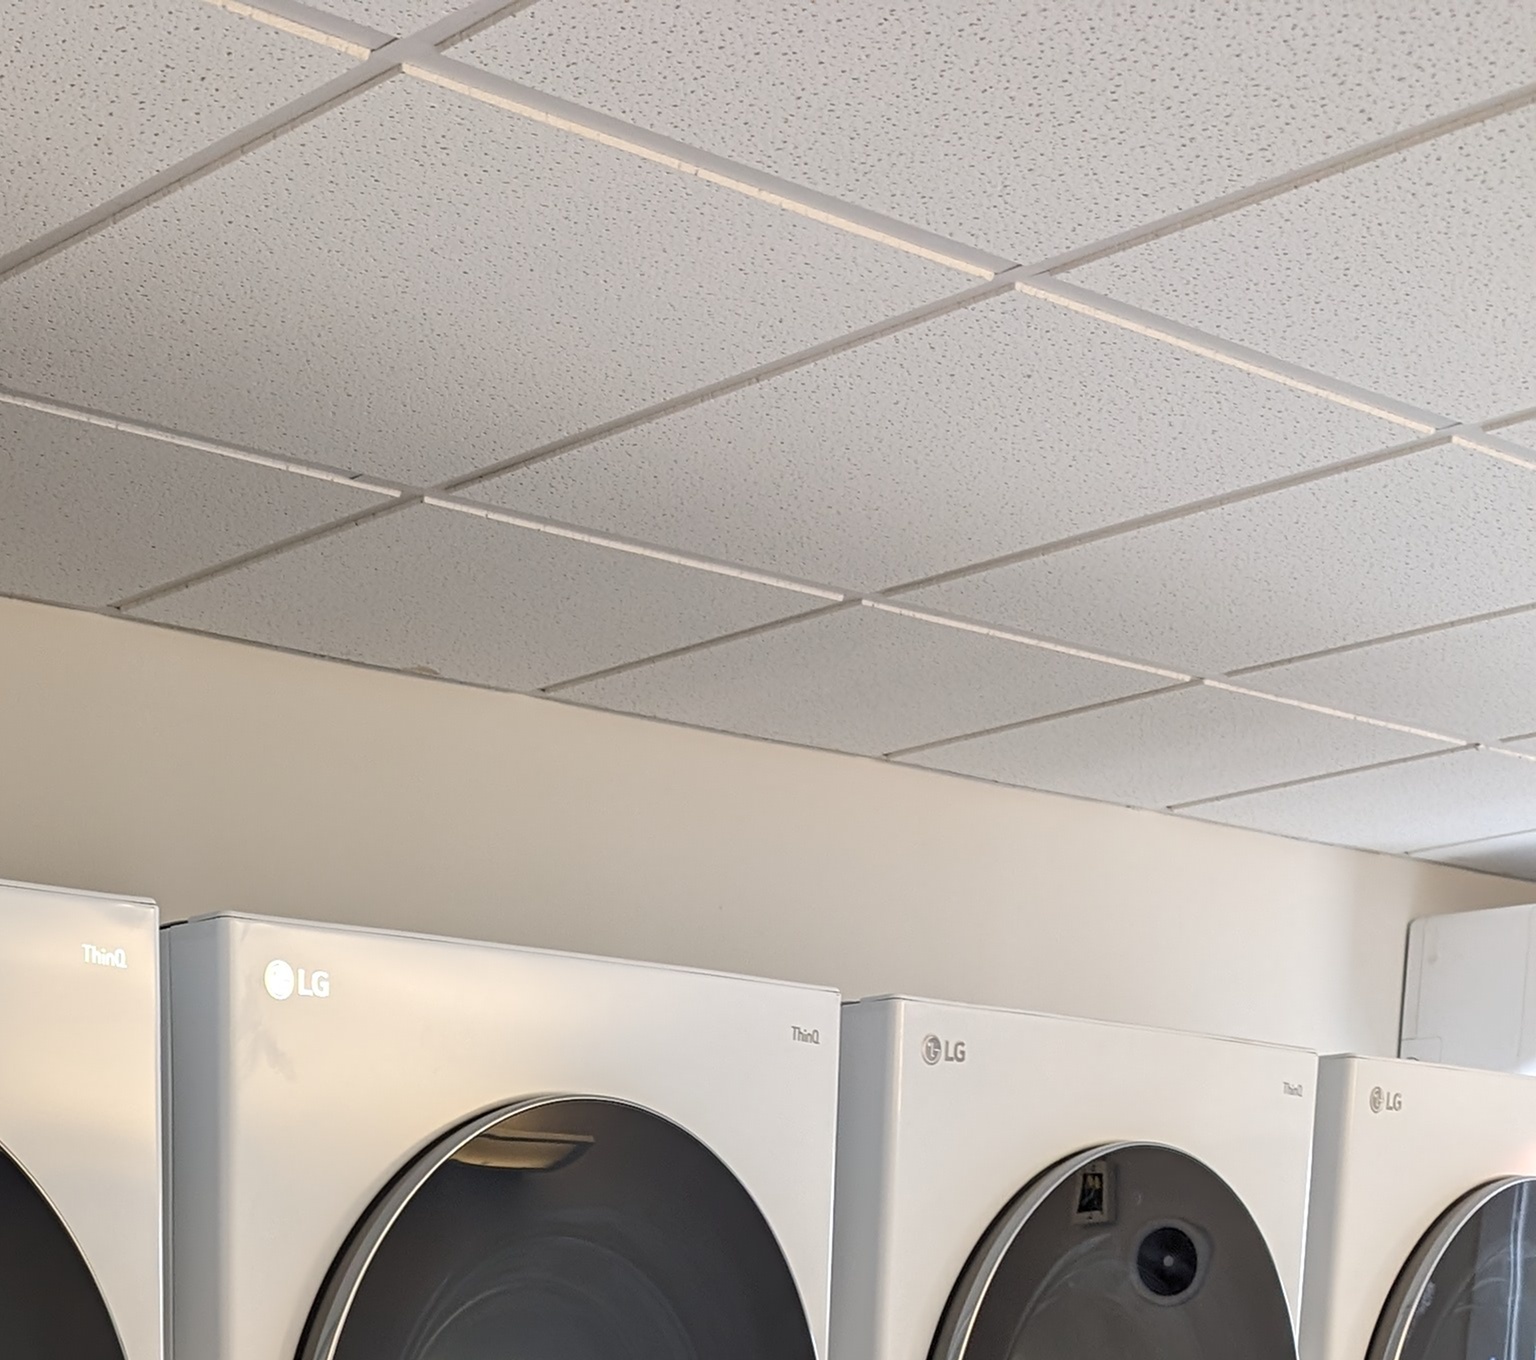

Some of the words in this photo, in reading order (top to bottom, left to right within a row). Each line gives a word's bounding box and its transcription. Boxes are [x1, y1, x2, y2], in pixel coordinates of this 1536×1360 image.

[81, 943, 128, 968] ThinQ
[297, 968, 330, 998] LG
[791, 1026, 821, 1045] ThinQ
[944, 1041, 966, 1062] LG
[1385, 1092, 1402, 1111] LG
